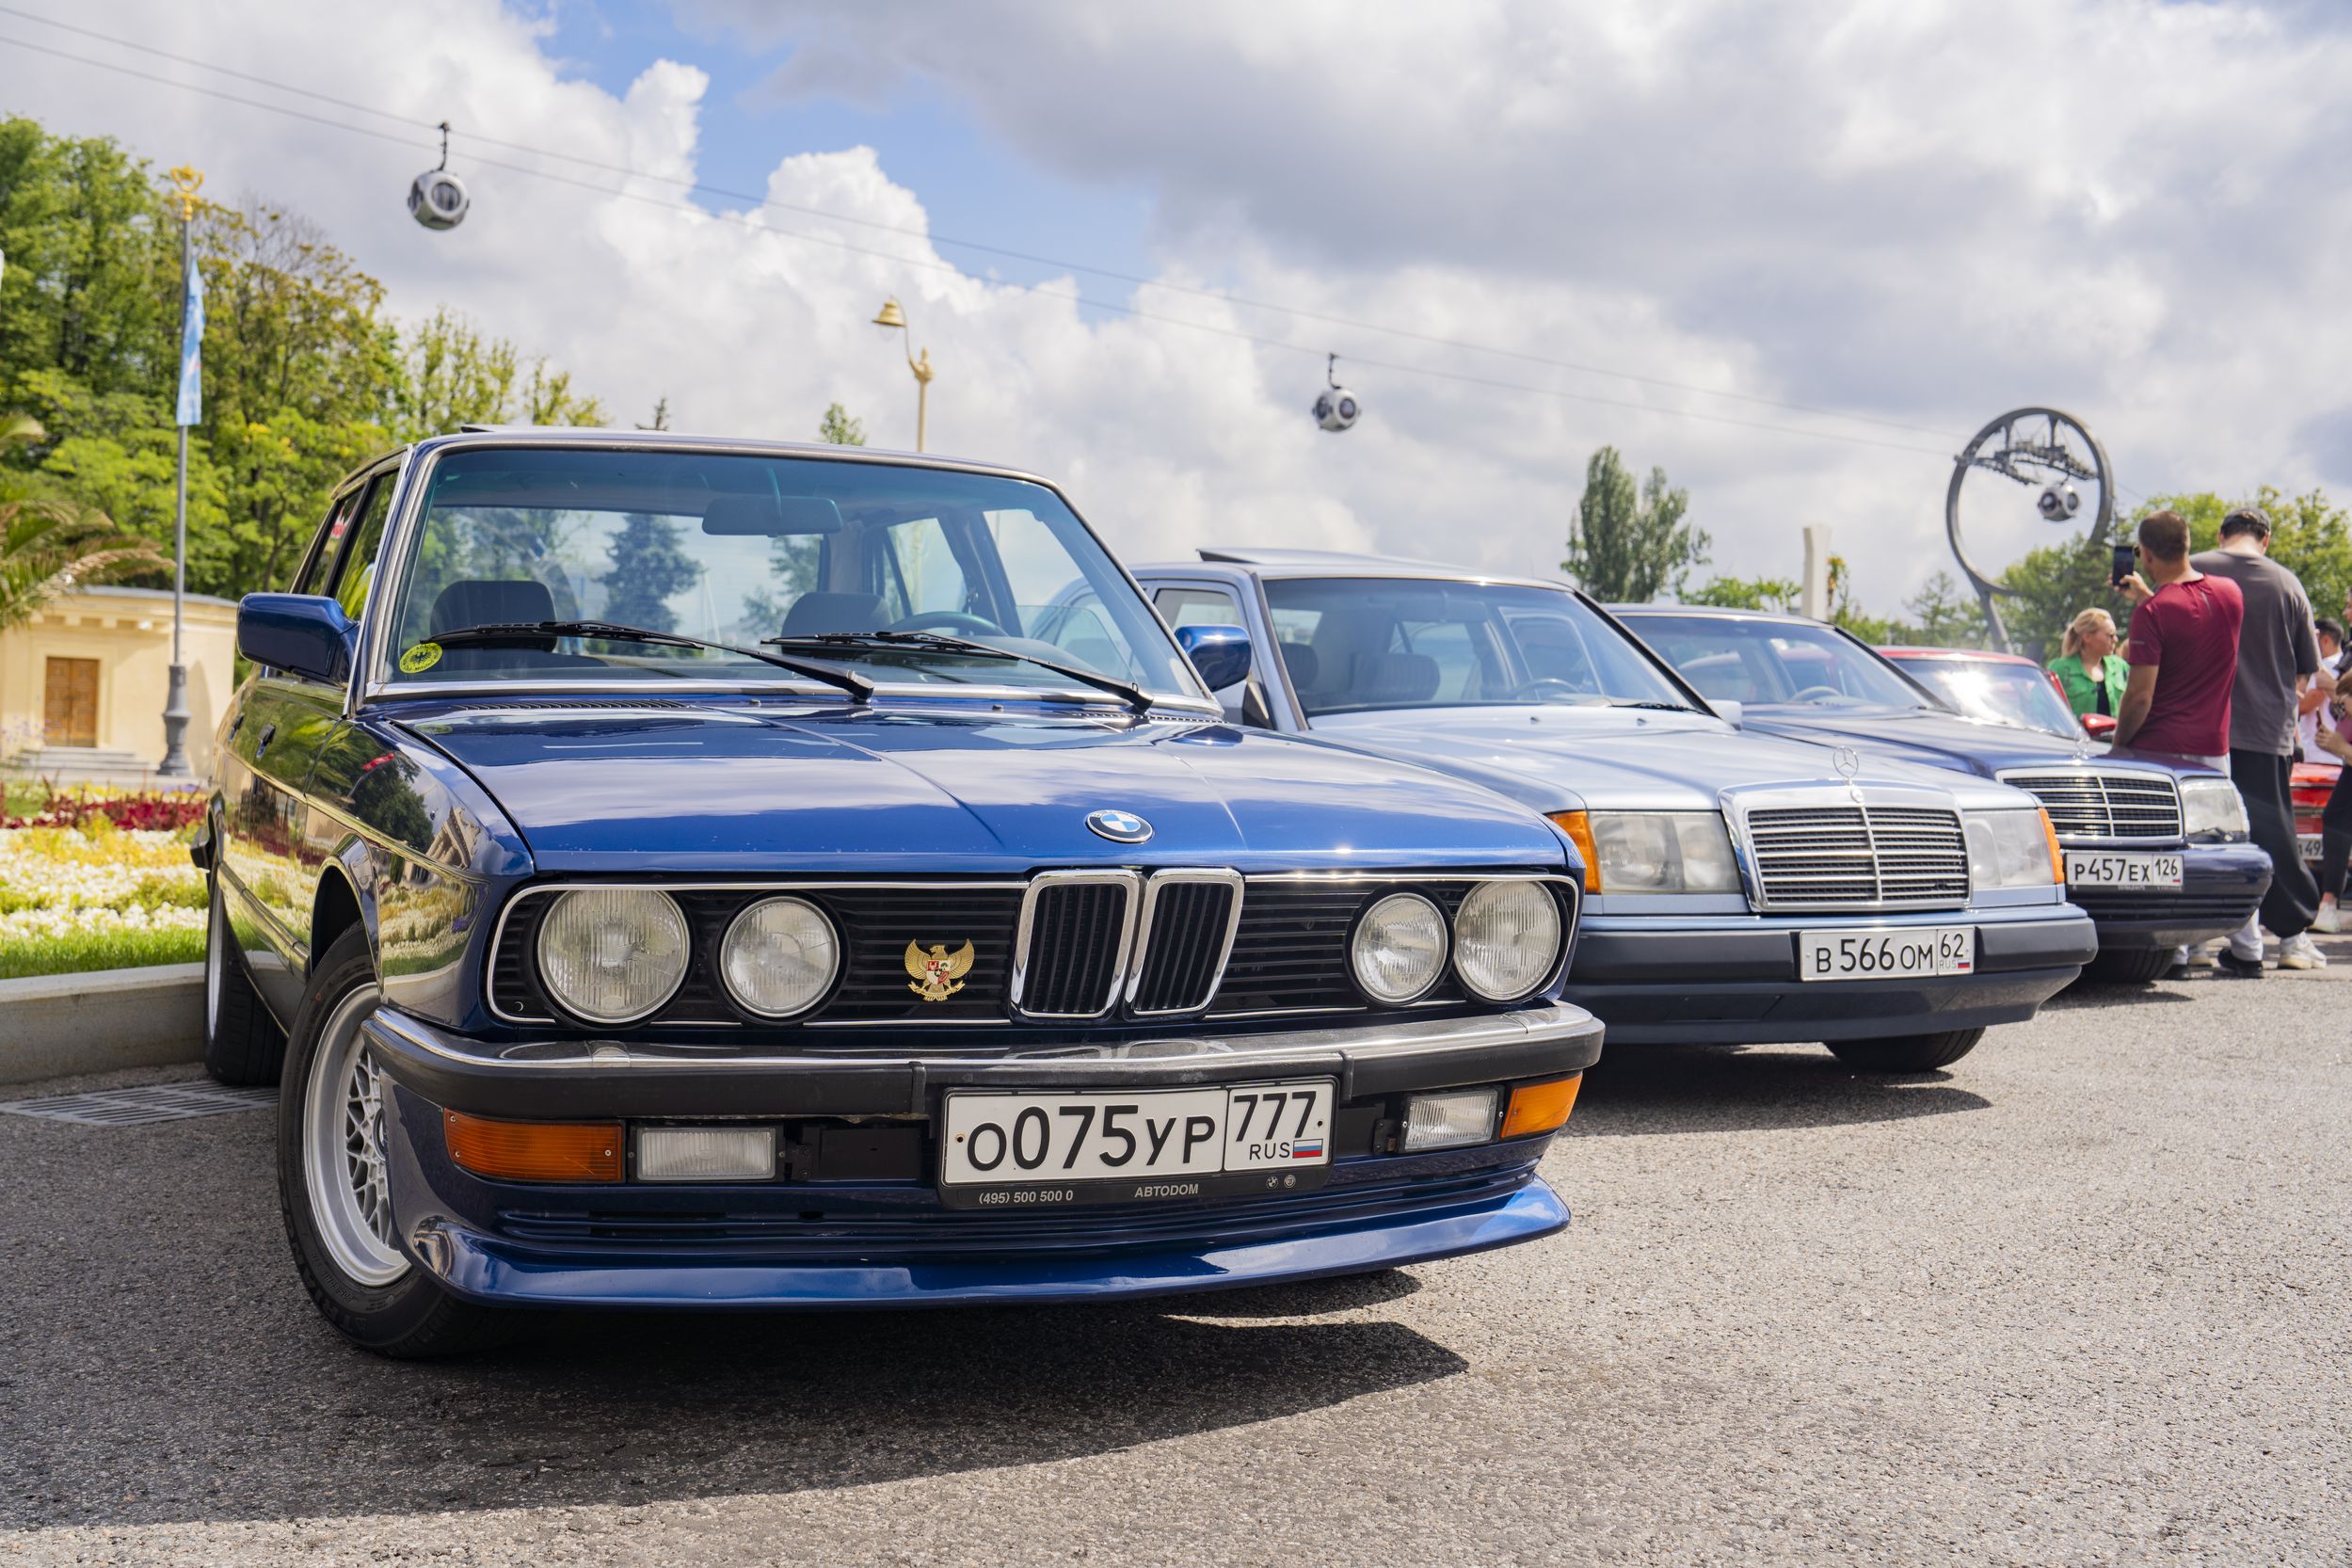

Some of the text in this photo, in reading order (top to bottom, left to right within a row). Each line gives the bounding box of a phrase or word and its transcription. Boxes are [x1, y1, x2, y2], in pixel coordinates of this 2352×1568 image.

[2074, 858, 2178, 882] Р457ЕХ 126
[1816, 933, 1964, 973] В566ОМ 62
[1939, 959, 1957, 969] RUS
[967, 1090, 1318, 1172] О075УР 777
[1249, 1142, 1290, 1160] RUS
[979, 1190, 1074, 1205] (495) 500 500 0
